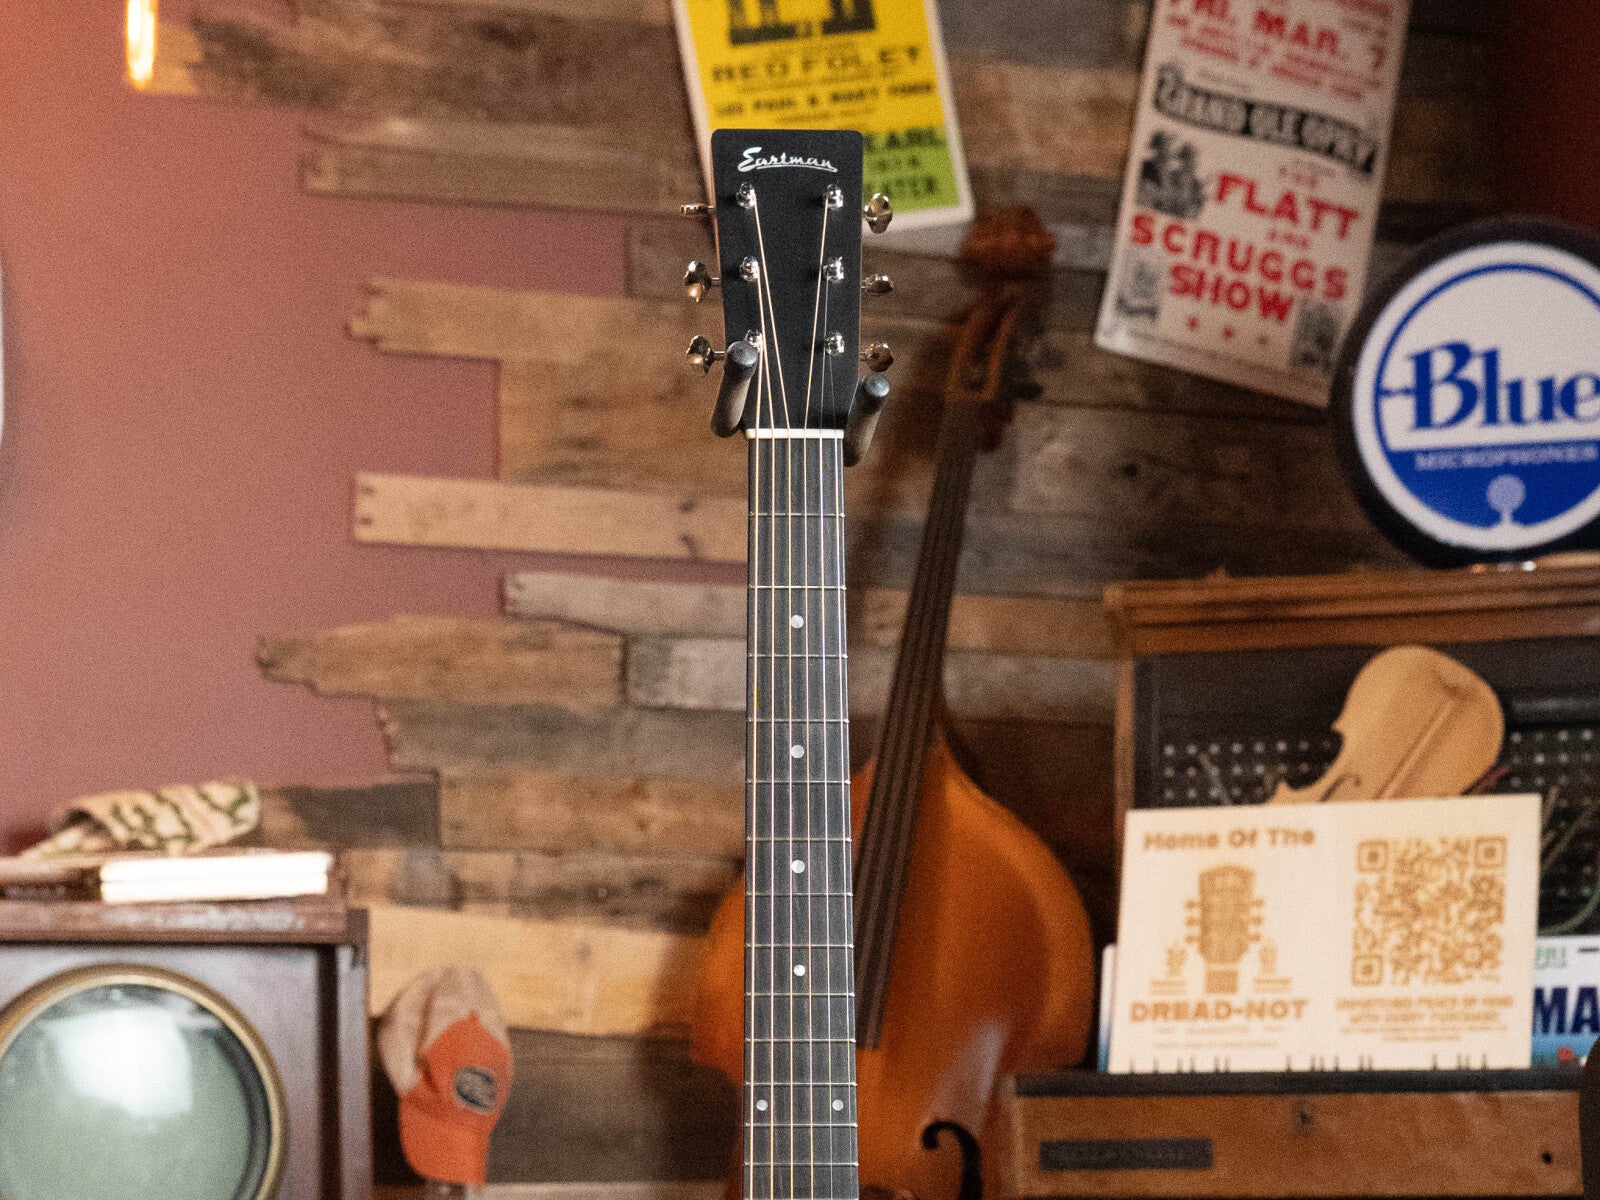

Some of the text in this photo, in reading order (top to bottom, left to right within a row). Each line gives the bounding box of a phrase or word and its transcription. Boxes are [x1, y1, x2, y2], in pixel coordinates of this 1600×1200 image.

[738, 147, 838, 173] Eastman
[1215, 171, 1360, 240] FLATT
[1131, 212, 1348, 300] SCRUGGS
[1168, 261, 1295, 323] SHOW
[1406, 340, 1600, 432] Blue
[1142, 825, 1316, 852] Home Of The
[1129, 997, 1310, 1023] DREAD-NOT
